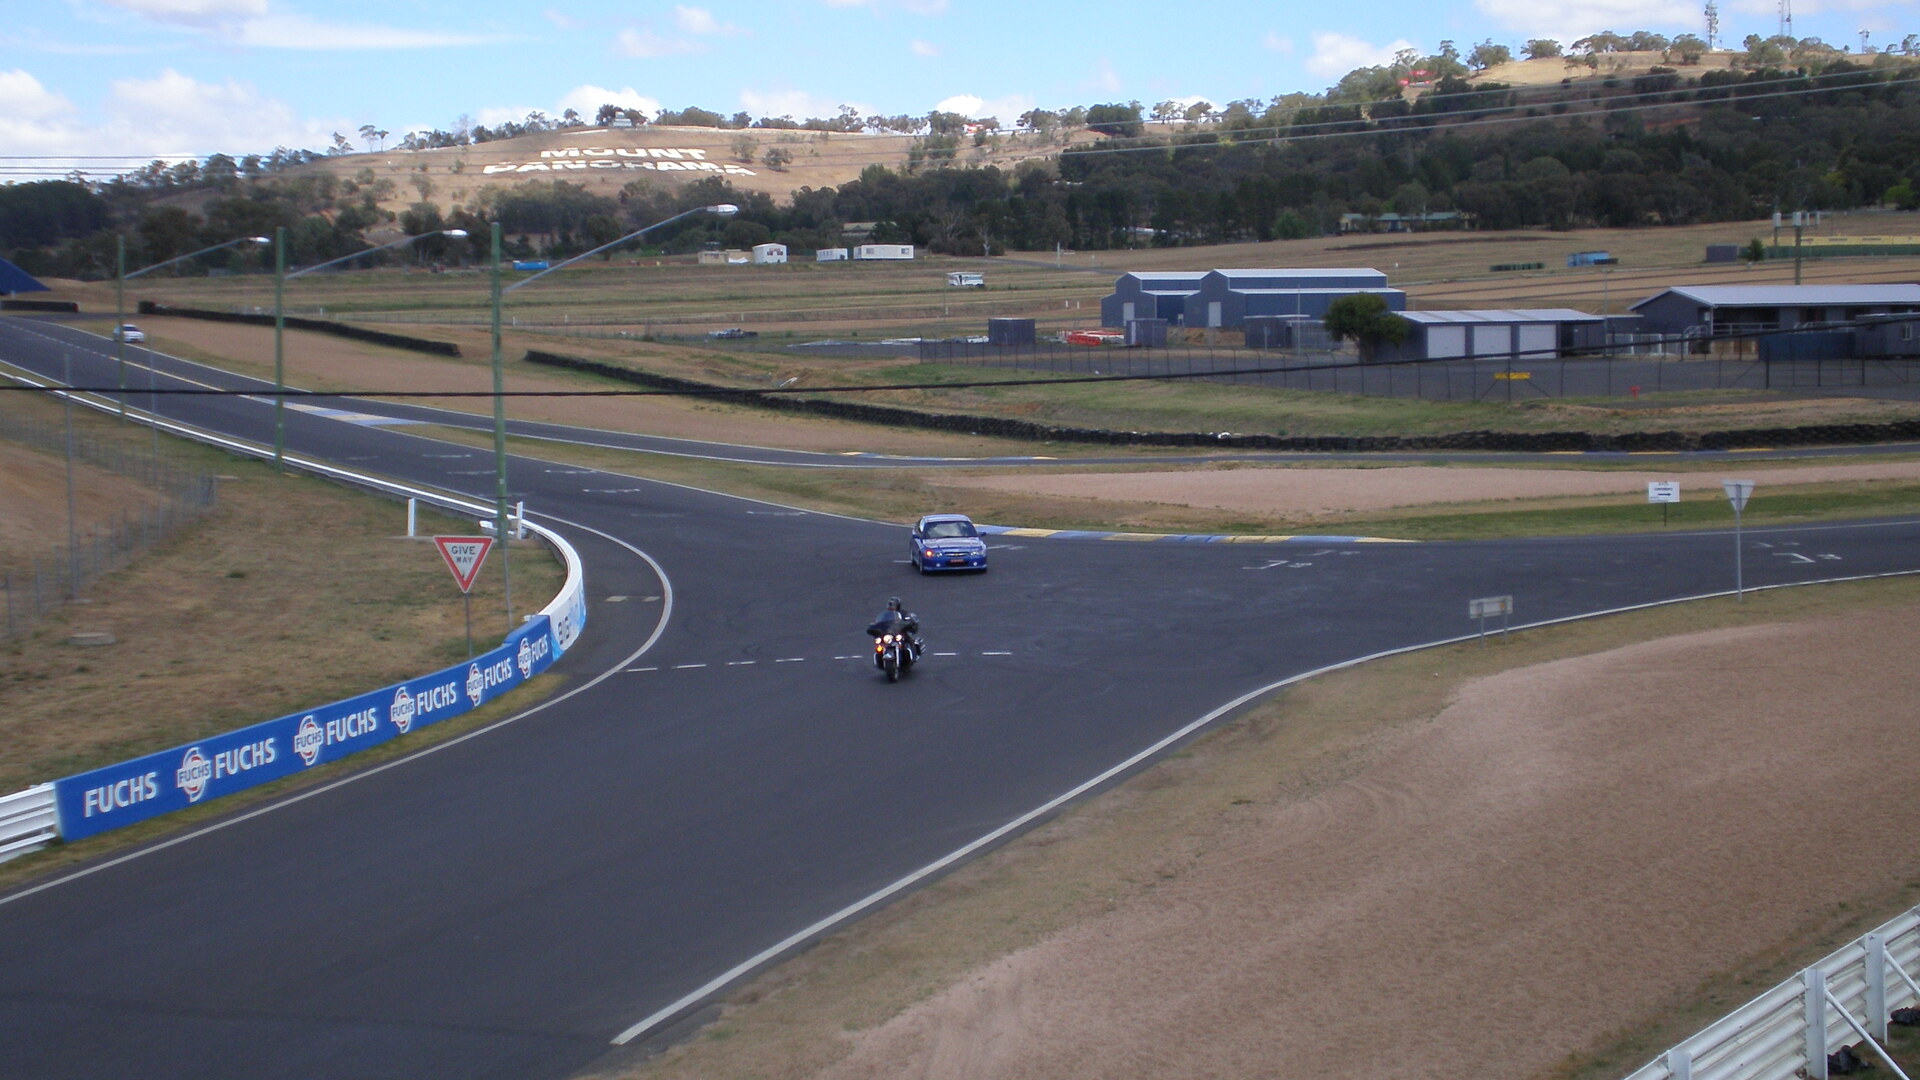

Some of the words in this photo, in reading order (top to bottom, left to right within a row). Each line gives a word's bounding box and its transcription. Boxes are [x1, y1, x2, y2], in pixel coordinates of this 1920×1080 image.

[540, 148, 706, 160] MOUNT
[451, 545, 476, 555] GIVE
[456, 556, 473, 564] WAY
[84, 771, 158, 818] FUCHS
[178, 763, 211, 784] FUCHS
[214, 737, 276, 779] FUCHS
[296, 729, 323, 748] FUCHS
[326, 707, 377, 746] FUCHS
[392, 701, 415, 717] FUCHS
[417, 681, 457, 716] FUCHS
[484, 657, 513, 690] FUCHS
